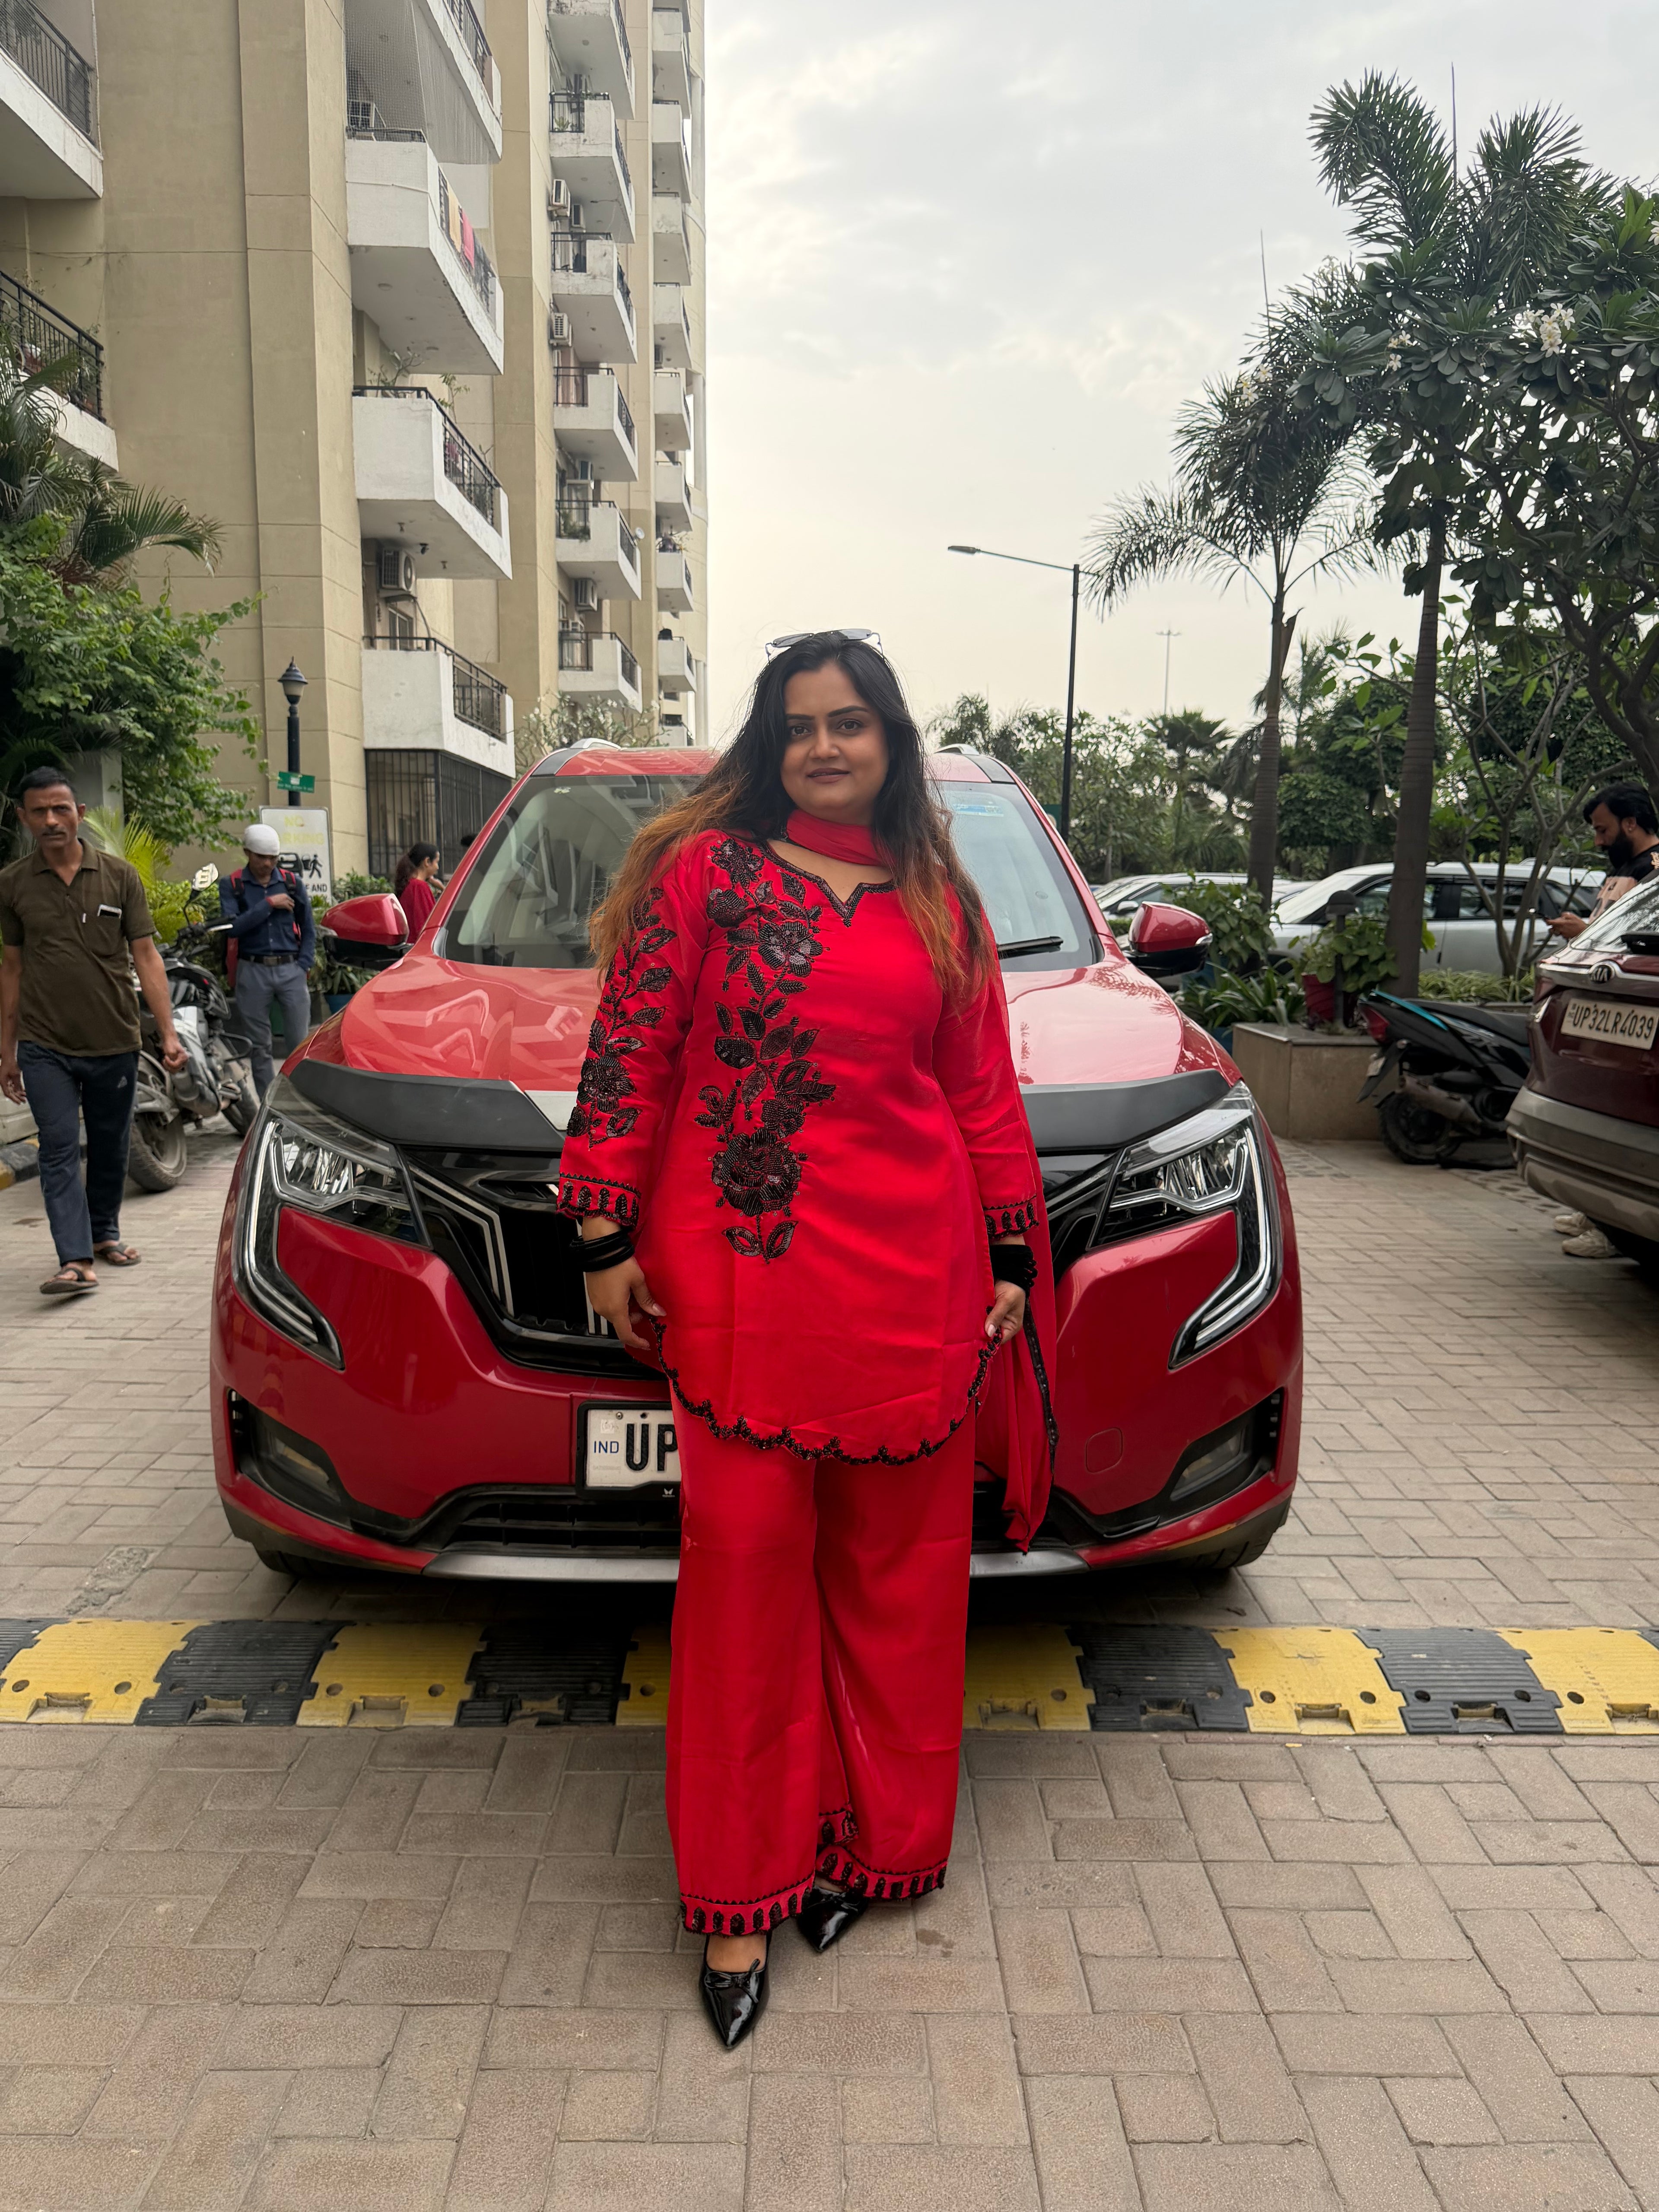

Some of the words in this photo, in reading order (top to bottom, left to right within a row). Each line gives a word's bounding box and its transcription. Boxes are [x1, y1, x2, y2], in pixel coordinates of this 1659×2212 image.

[284, 815, 304, 827] NO
[282, 832, 324, 845] RKING
[312, 884, 327, 893] AND
[1591, 967, 1608, 982] KIA
[1573, 1005, 1654, 1039] UP32LR4039
[594, 1441, 619, 1453] IND
[626, 1424, 678, 1471] UP
